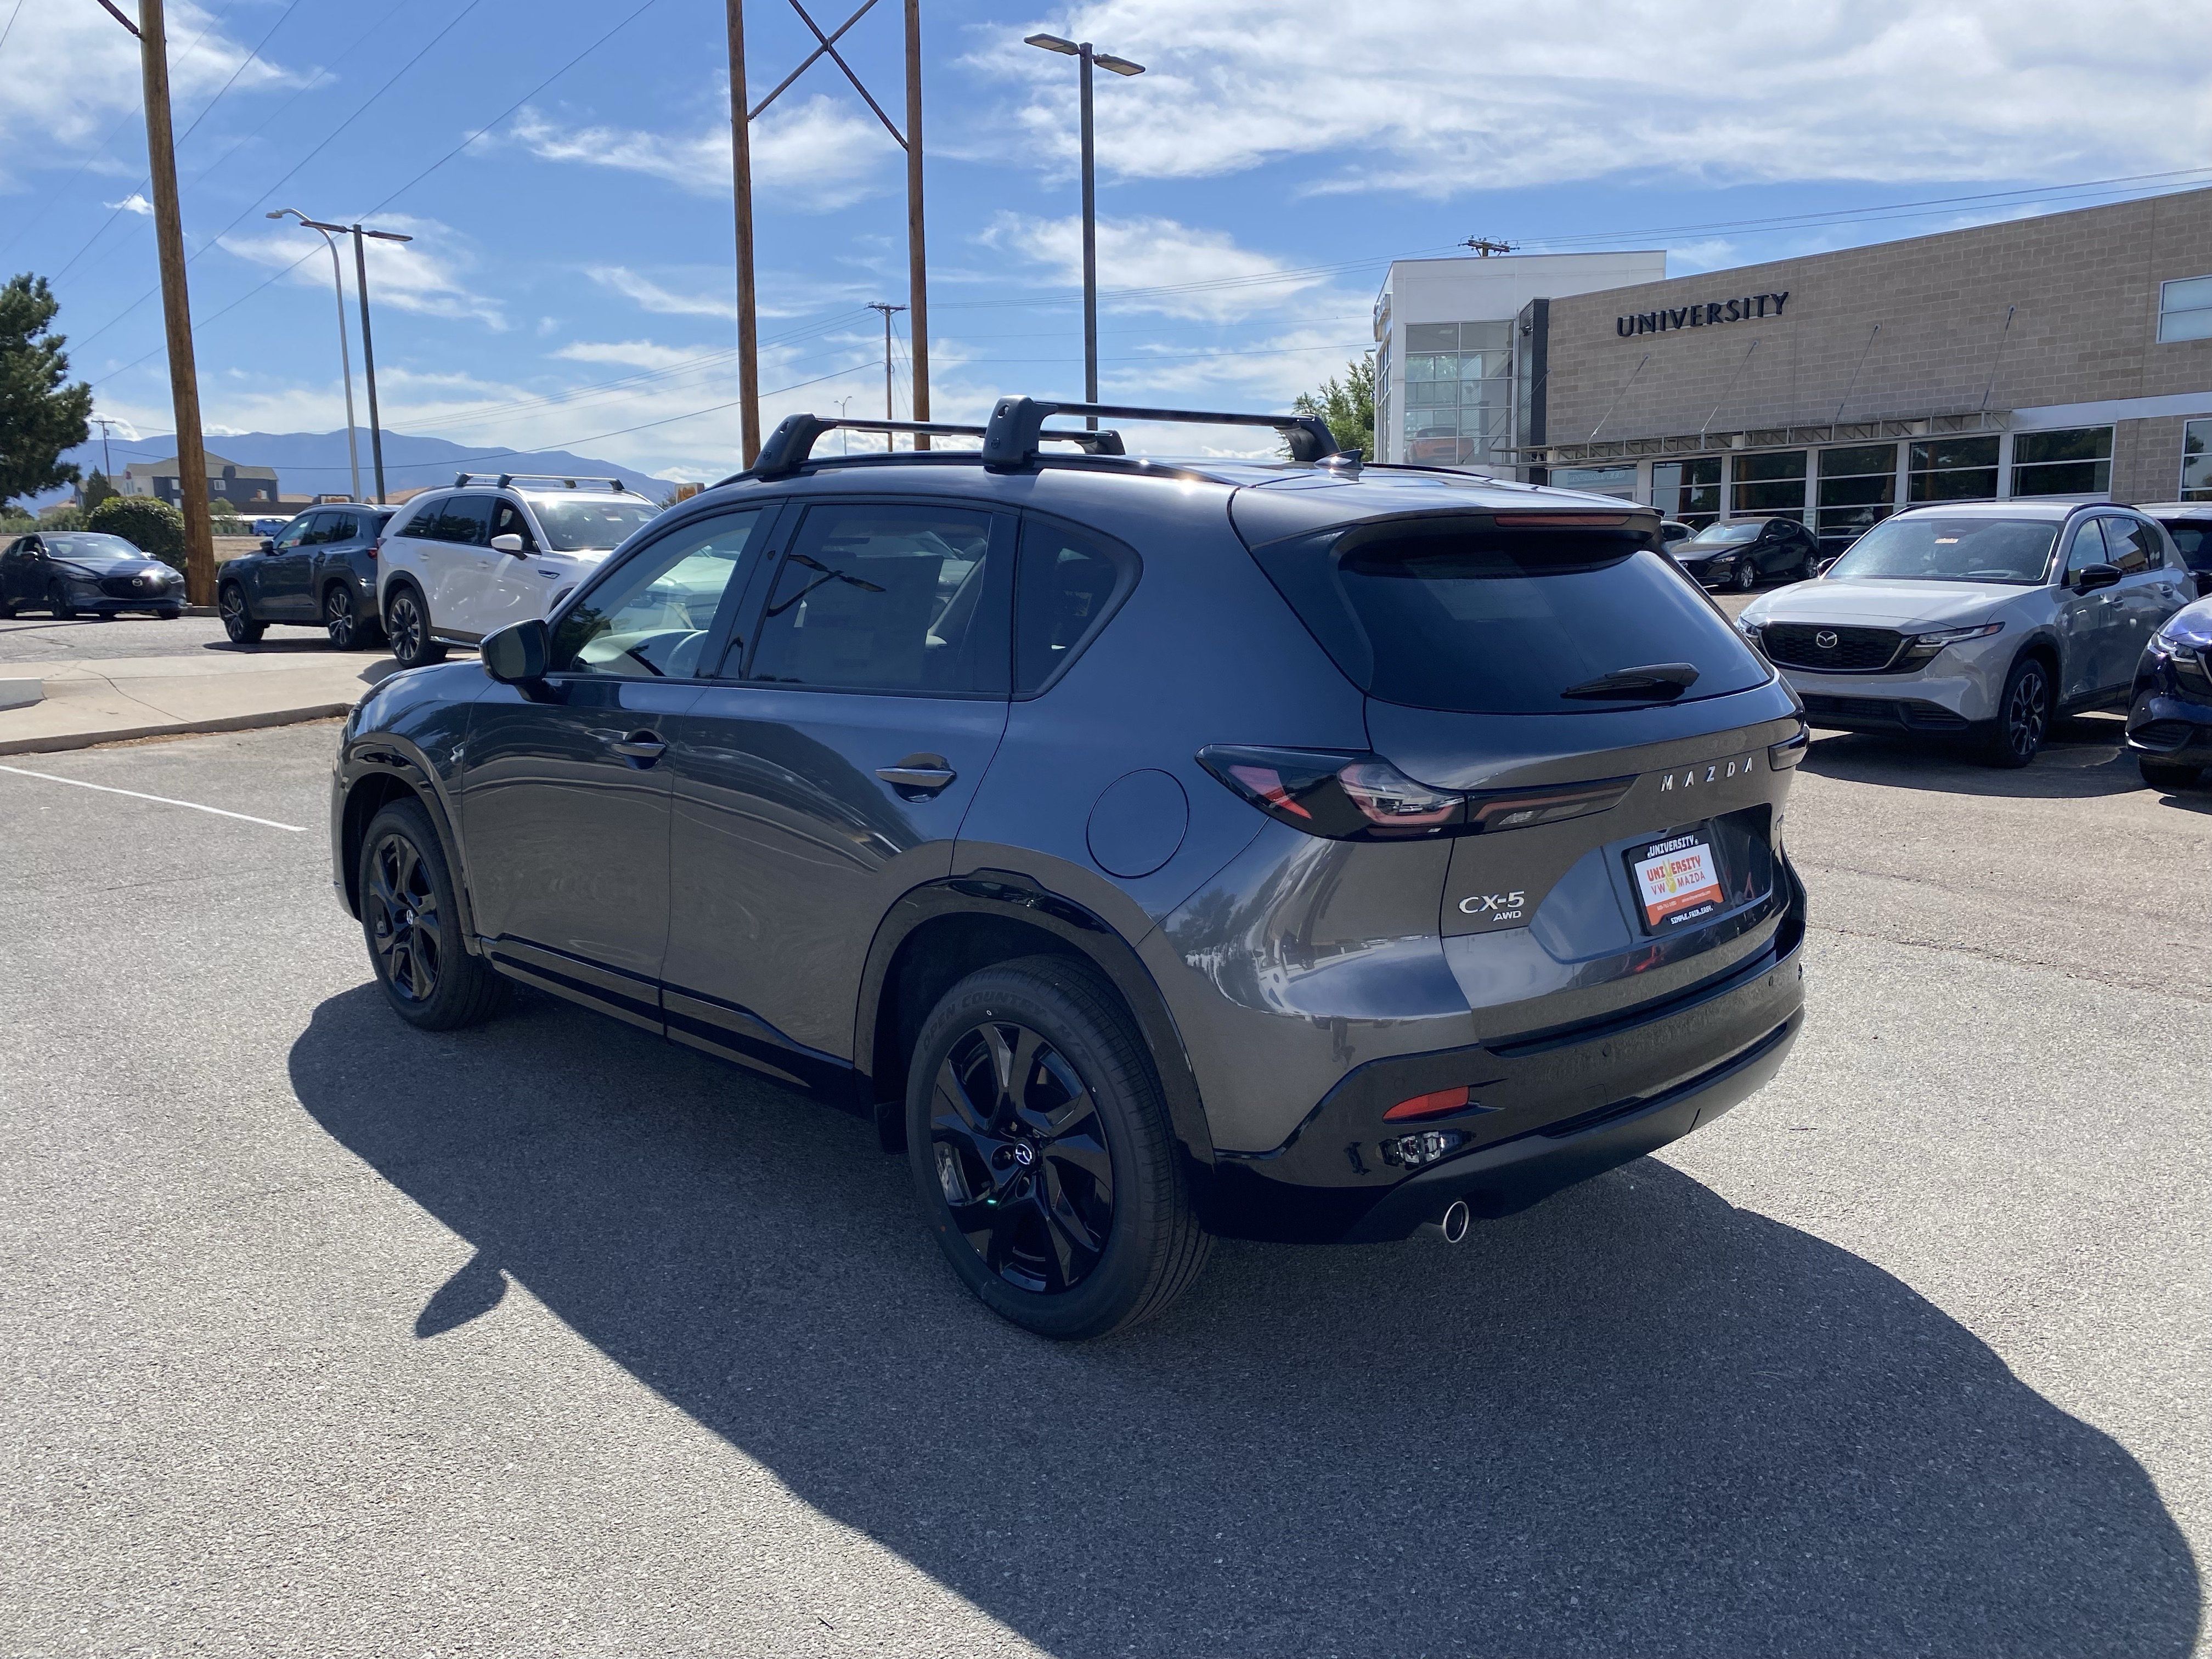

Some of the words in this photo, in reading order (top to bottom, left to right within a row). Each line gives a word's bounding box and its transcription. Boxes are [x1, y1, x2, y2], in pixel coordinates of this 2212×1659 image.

[1617, 291, 1789, 337] UNIVERSITY
[1661, 757, 1752, 792] MAZDA
[1649, 834, 1694, 857] UNIVERSITY
[1651, 883, 1666, 895] VW
[1677, 871, 1706, 887] MAZDA
[1459, 890, 1525, 913] CX-5
[1493, 910, 1522, 922] AWD
